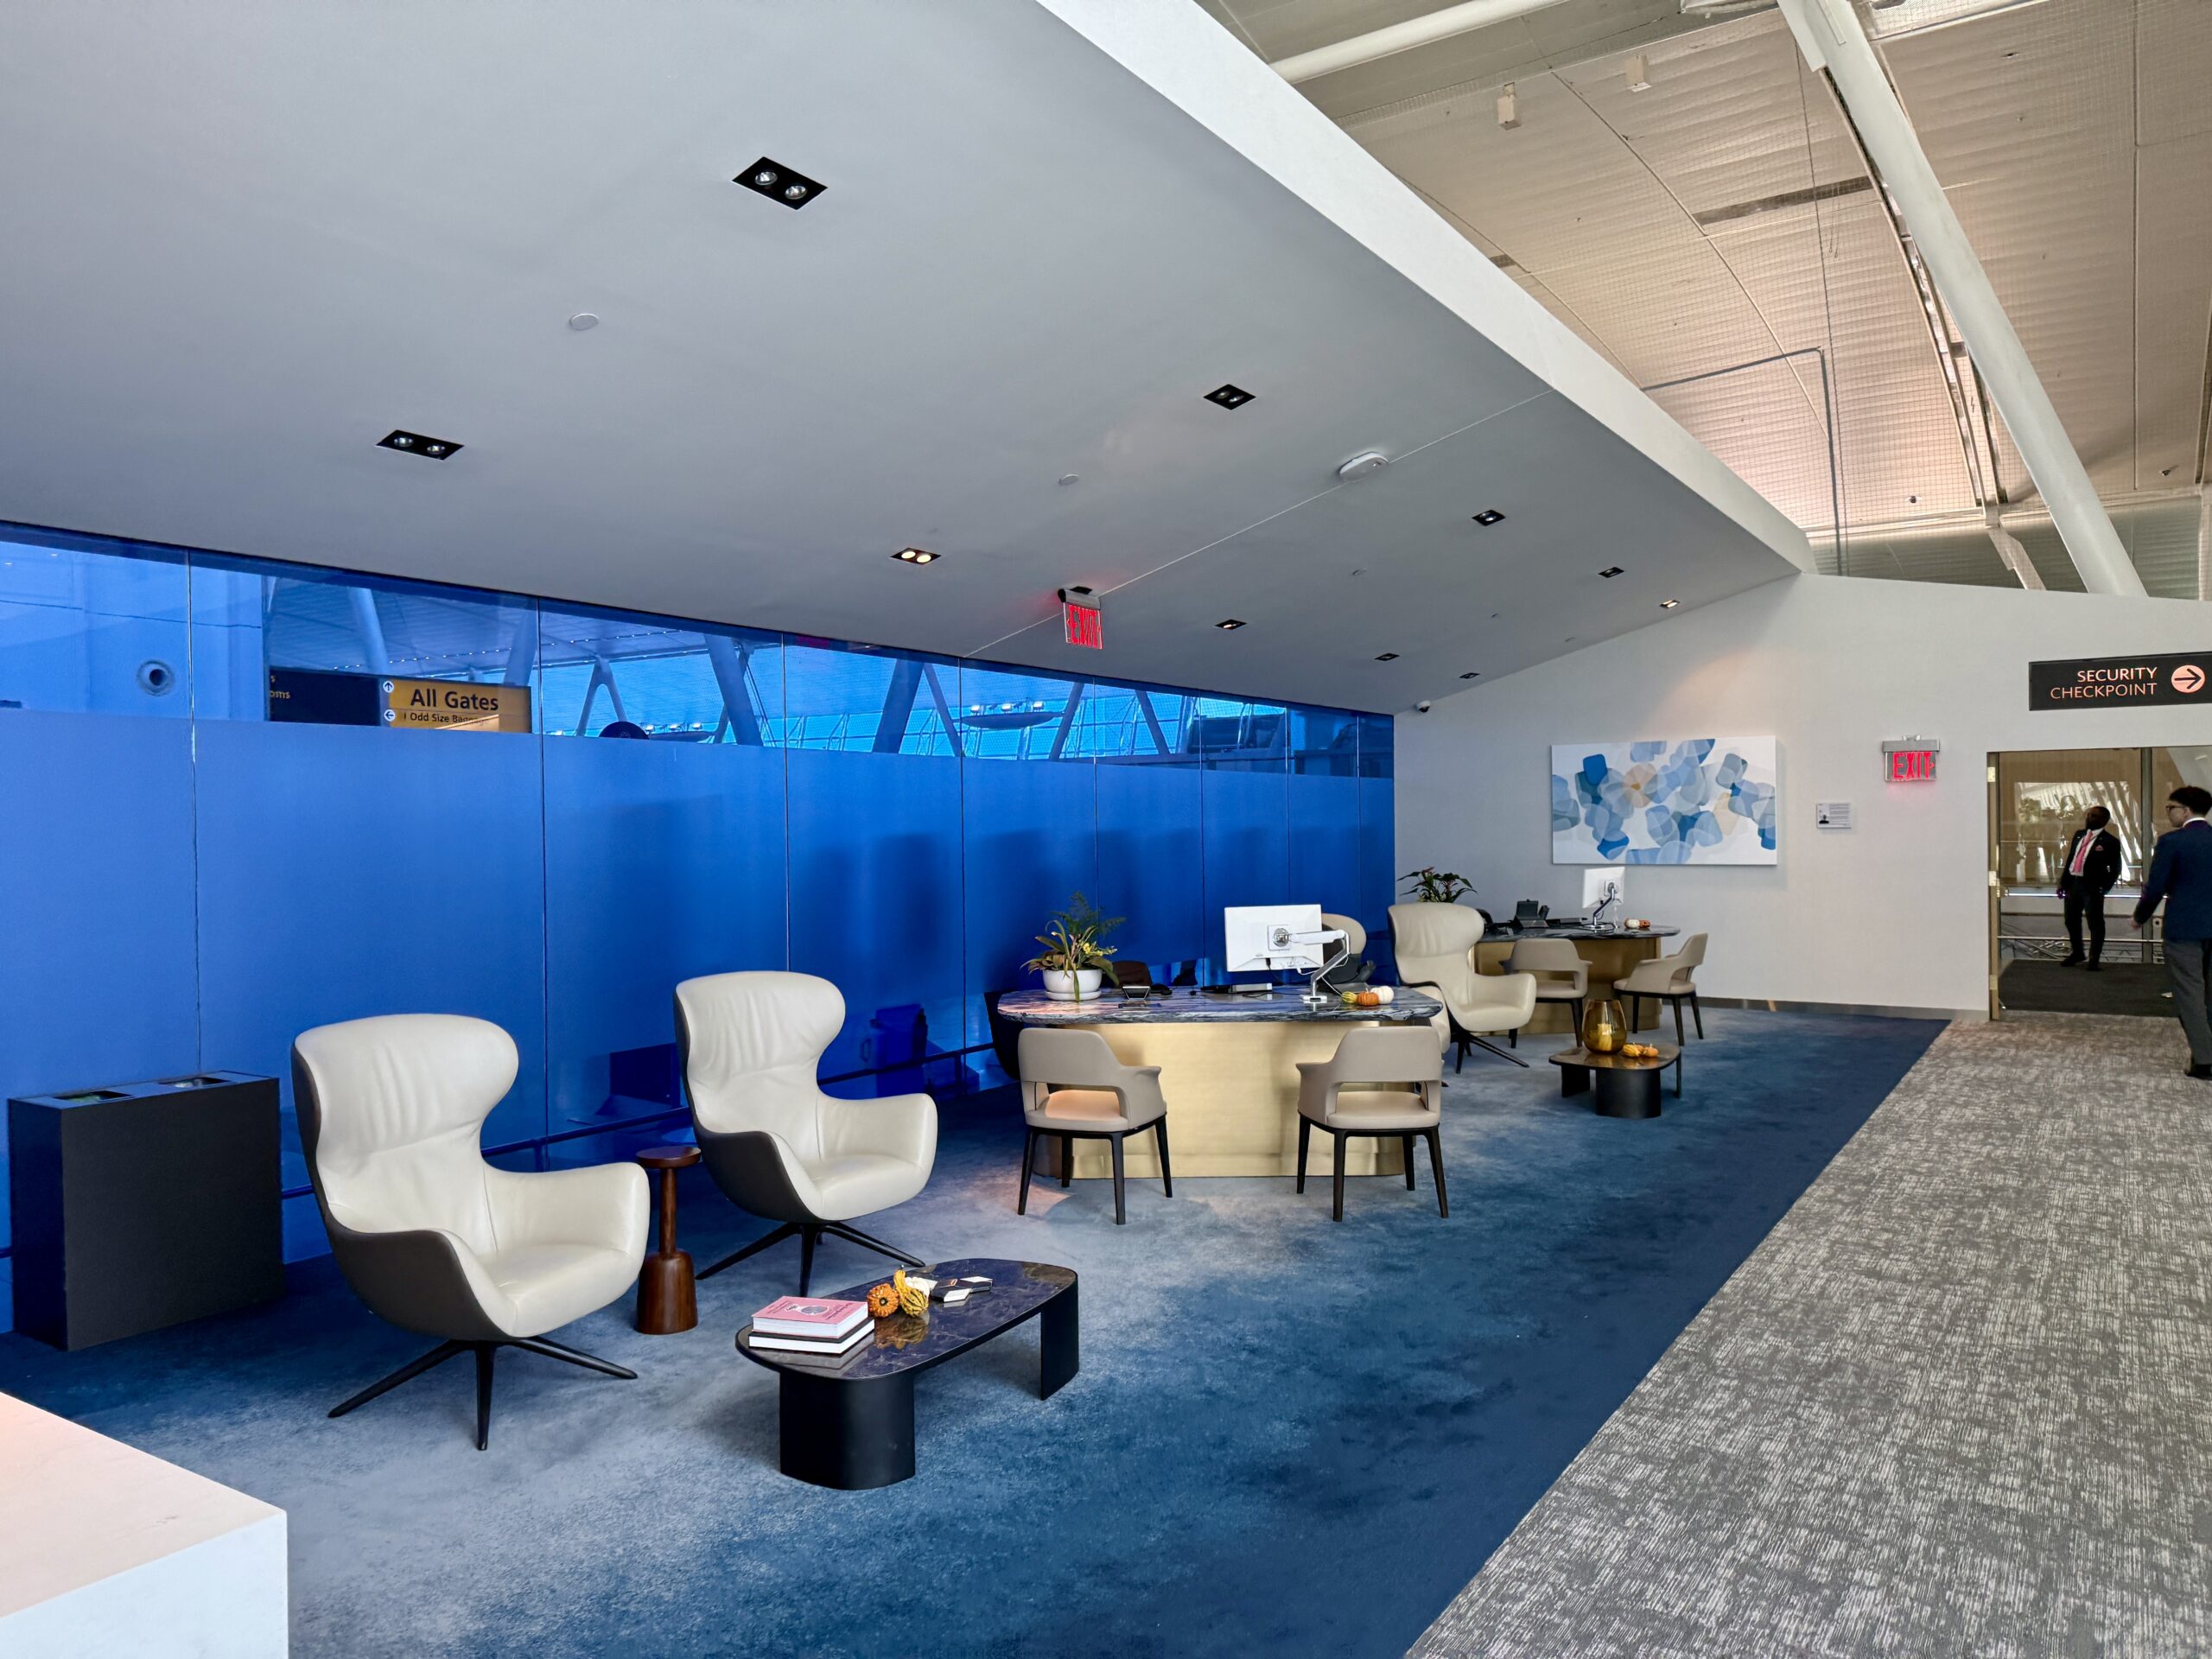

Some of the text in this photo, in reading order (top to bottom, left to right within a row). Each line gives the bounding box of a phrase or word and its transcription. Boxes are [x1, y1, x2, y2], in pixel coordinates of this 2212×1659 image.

[1069, 605, 1098, 648] EXIT
[2077, 667, 2158, 683] SECURITY
[410, 689, 499, 711] All Gates
[2050, 683, 2158, 699] CHECKPOINT
[410, 712, 429, 721] Odd
[431, 713, 450, 723] Size
[1893, 752, 1932, 779] EXIT
